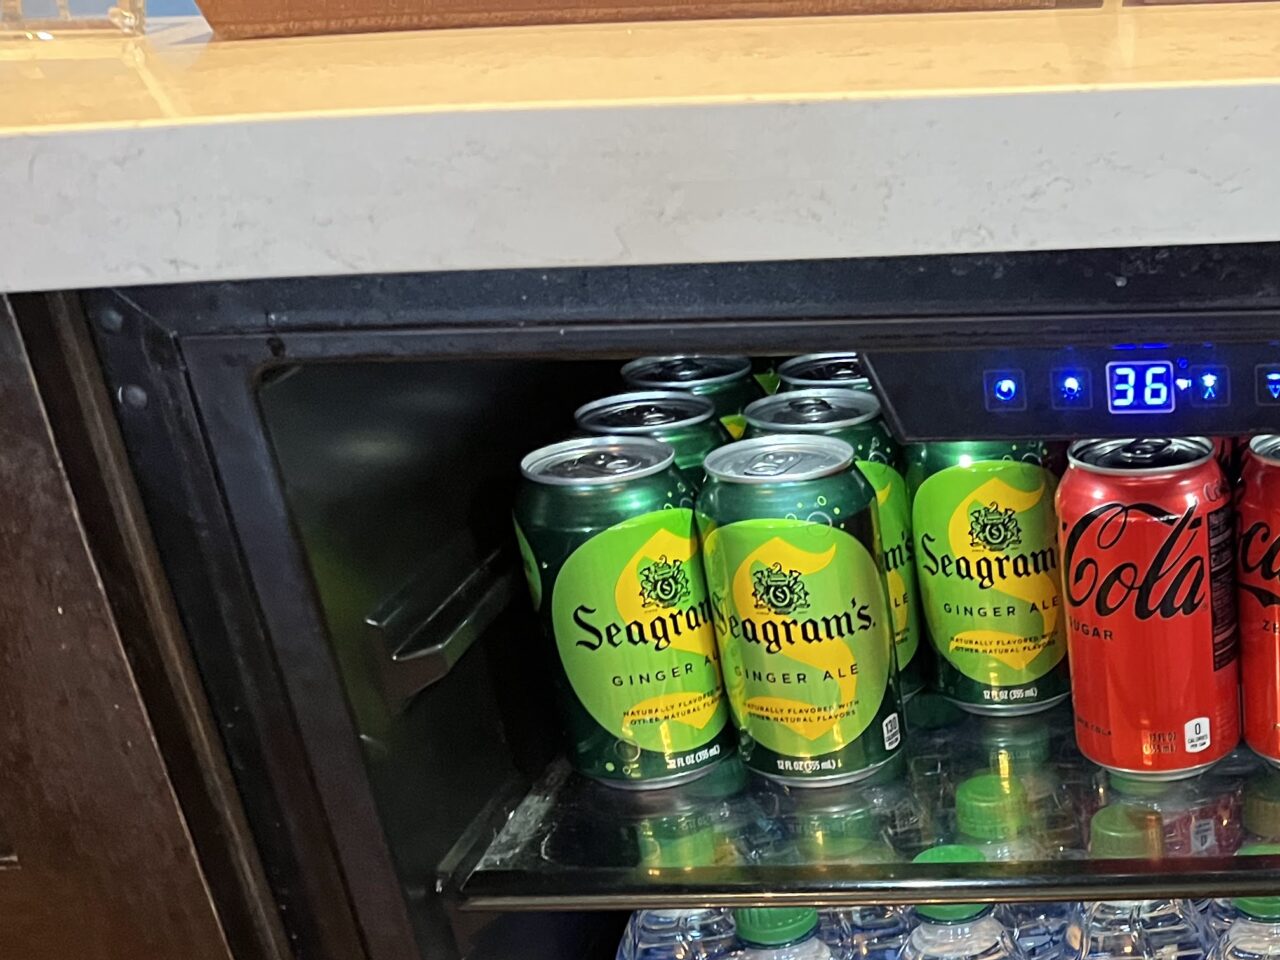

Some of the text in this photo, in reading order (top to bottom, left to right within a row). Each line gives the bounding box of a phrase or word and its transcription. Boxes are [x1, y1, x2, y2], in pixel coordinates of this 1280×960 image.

[1113, 366, 1168, 406] 36
[944, 596, 1059, 617] GINGER ALE
[713, 592, 872, 655] Seagram's
[612, 663, 694, 687] GINGER
[734, 663, 859, 684] GINGER ALE
[885, 716, 898, 733] 130
[1195, 721, 1202, 735] 0
[776, 760, 784, 770] 12
[784, 761, 793, 771] FL
